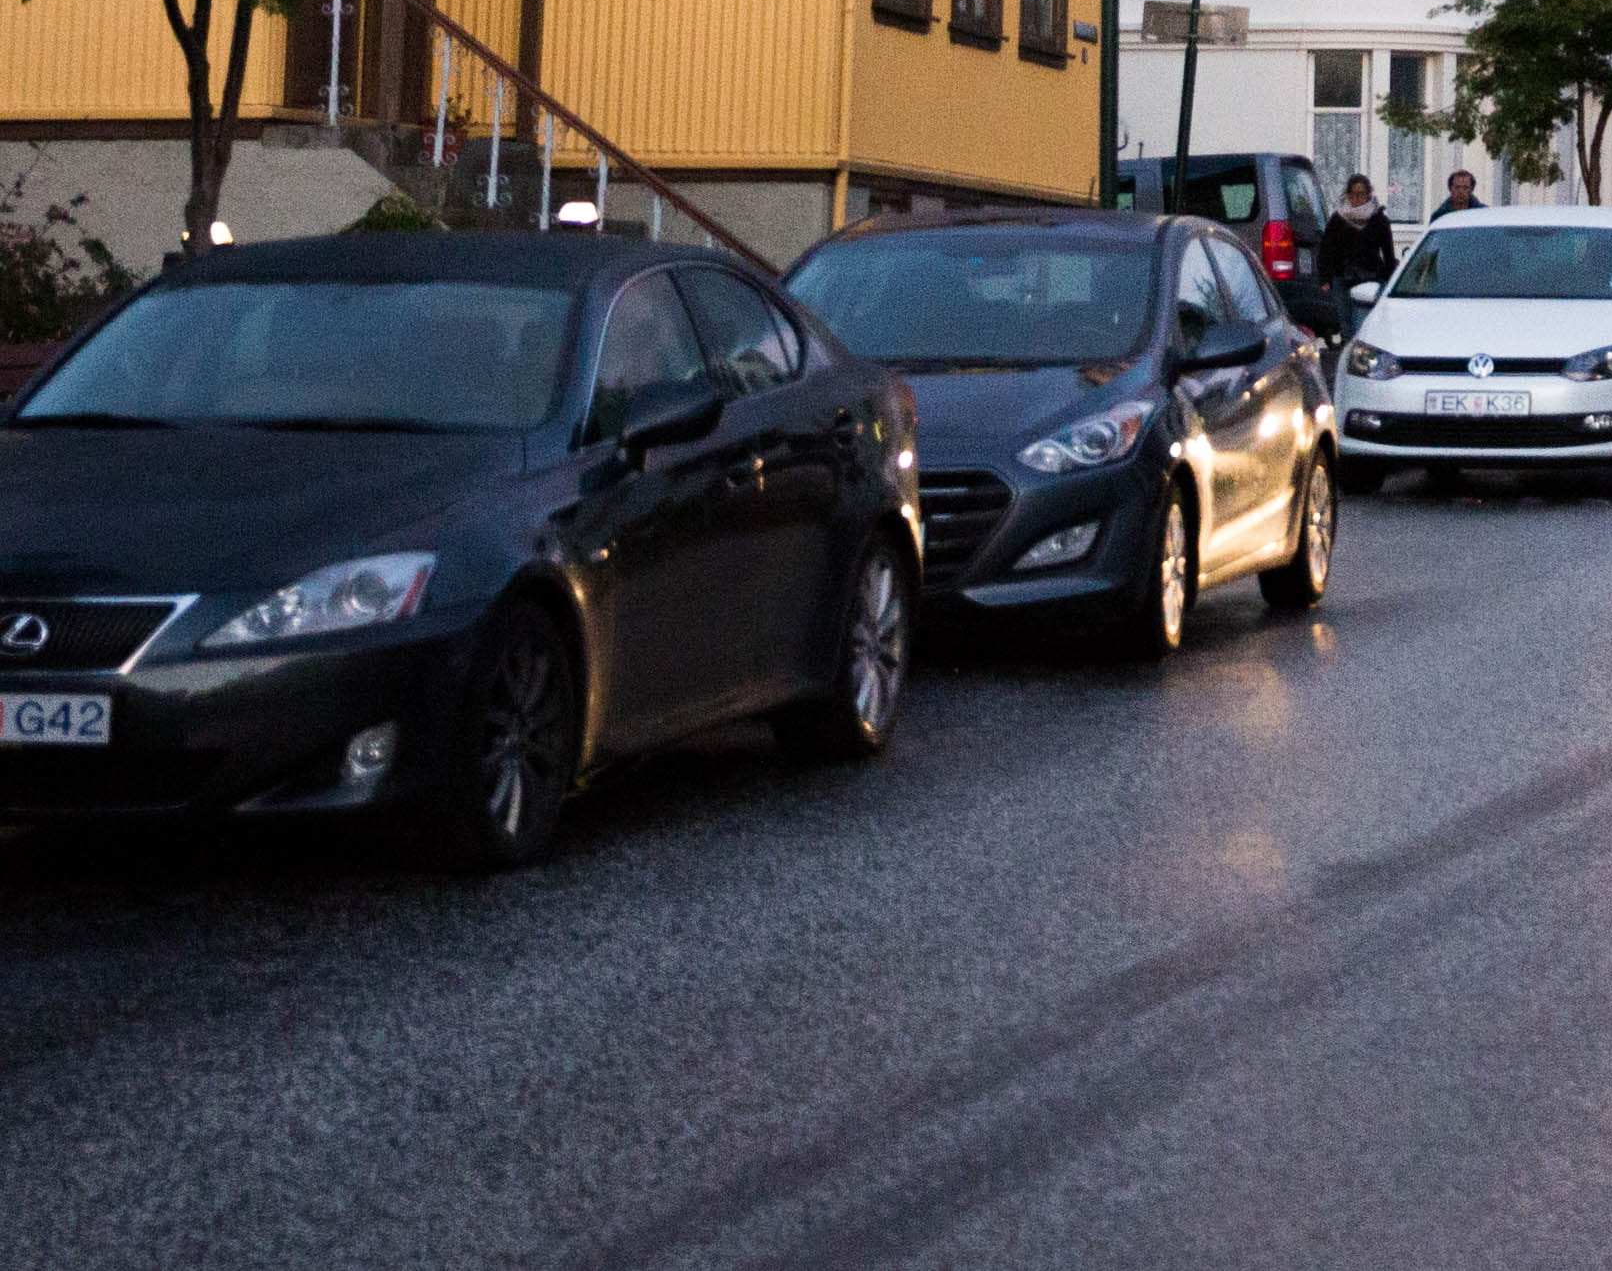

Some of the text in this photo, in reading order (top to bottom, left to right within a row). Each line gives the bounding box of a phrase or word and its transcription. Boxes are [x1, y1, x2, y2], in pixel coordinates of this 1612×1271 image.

[1441, 395, 1525, 412] EK K36
[15, 700, 104, 736] G42
